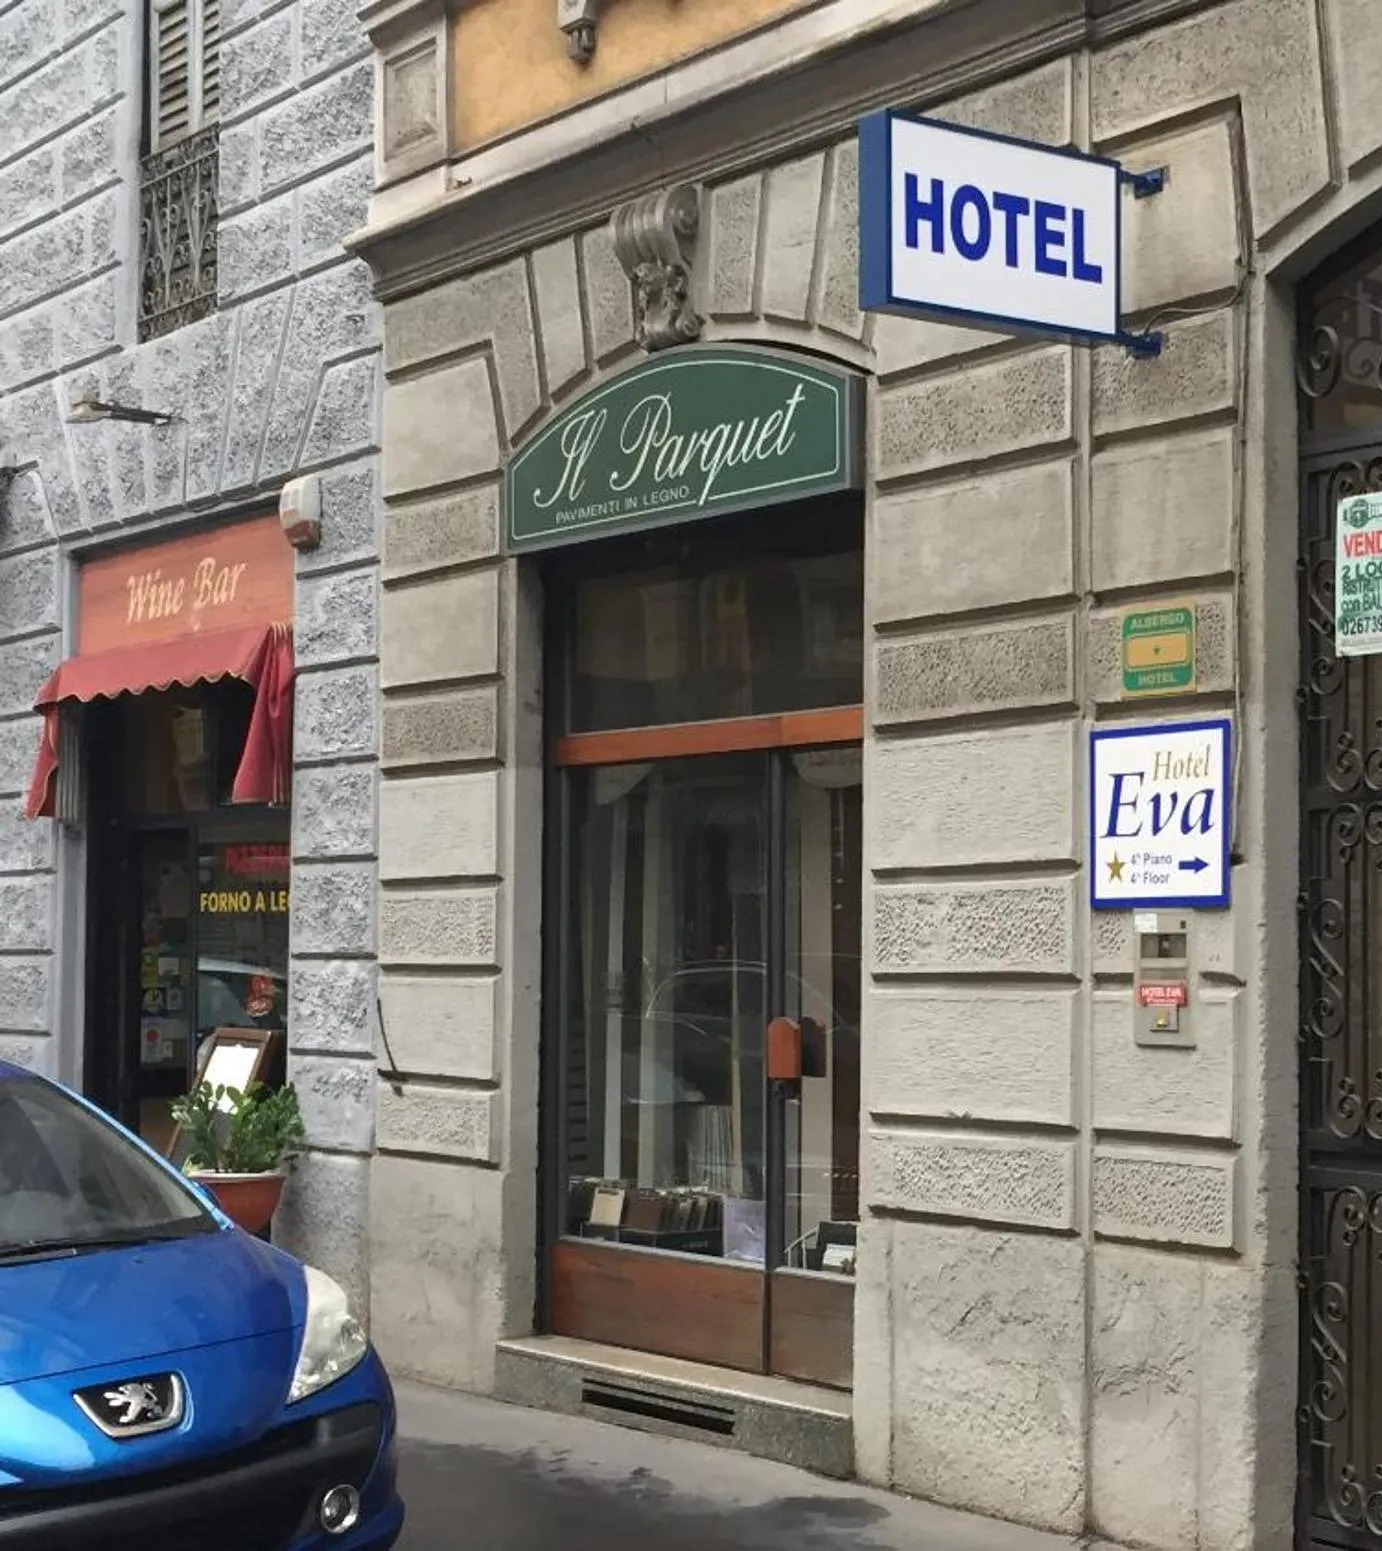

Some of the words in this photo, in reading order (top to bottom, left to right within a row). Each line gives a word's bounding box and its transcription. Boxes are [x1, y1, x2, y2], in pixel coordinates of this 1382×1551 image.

[904, 162, 1103, 284] HOTEL
[533, 408, 607, 507] Il
[609, 383, 805, 506] Parquet
[556, 500, 620, 524] PAVIMENTI
[624, 497, 638, 510] IN
[643, 485, 690, 506] LEGNO
[127, 568, 185, 623] Wine
[193, 557, 246, 611] Bar
[1342, 565, 1352, 580] 2
[1138, 671, 1178, 686] HOTEL
[1152, 743, 1211, 781] Hotel
[1100, 771, 1215, 838] Eva
[1143, 852, 1172, 866] Piano
[1143, 871, 1171, 885] Floor
[200, 890, 251, 912] FORNO
[255, 890, 266, 912] A
[270, 890, 290, 912] LE
